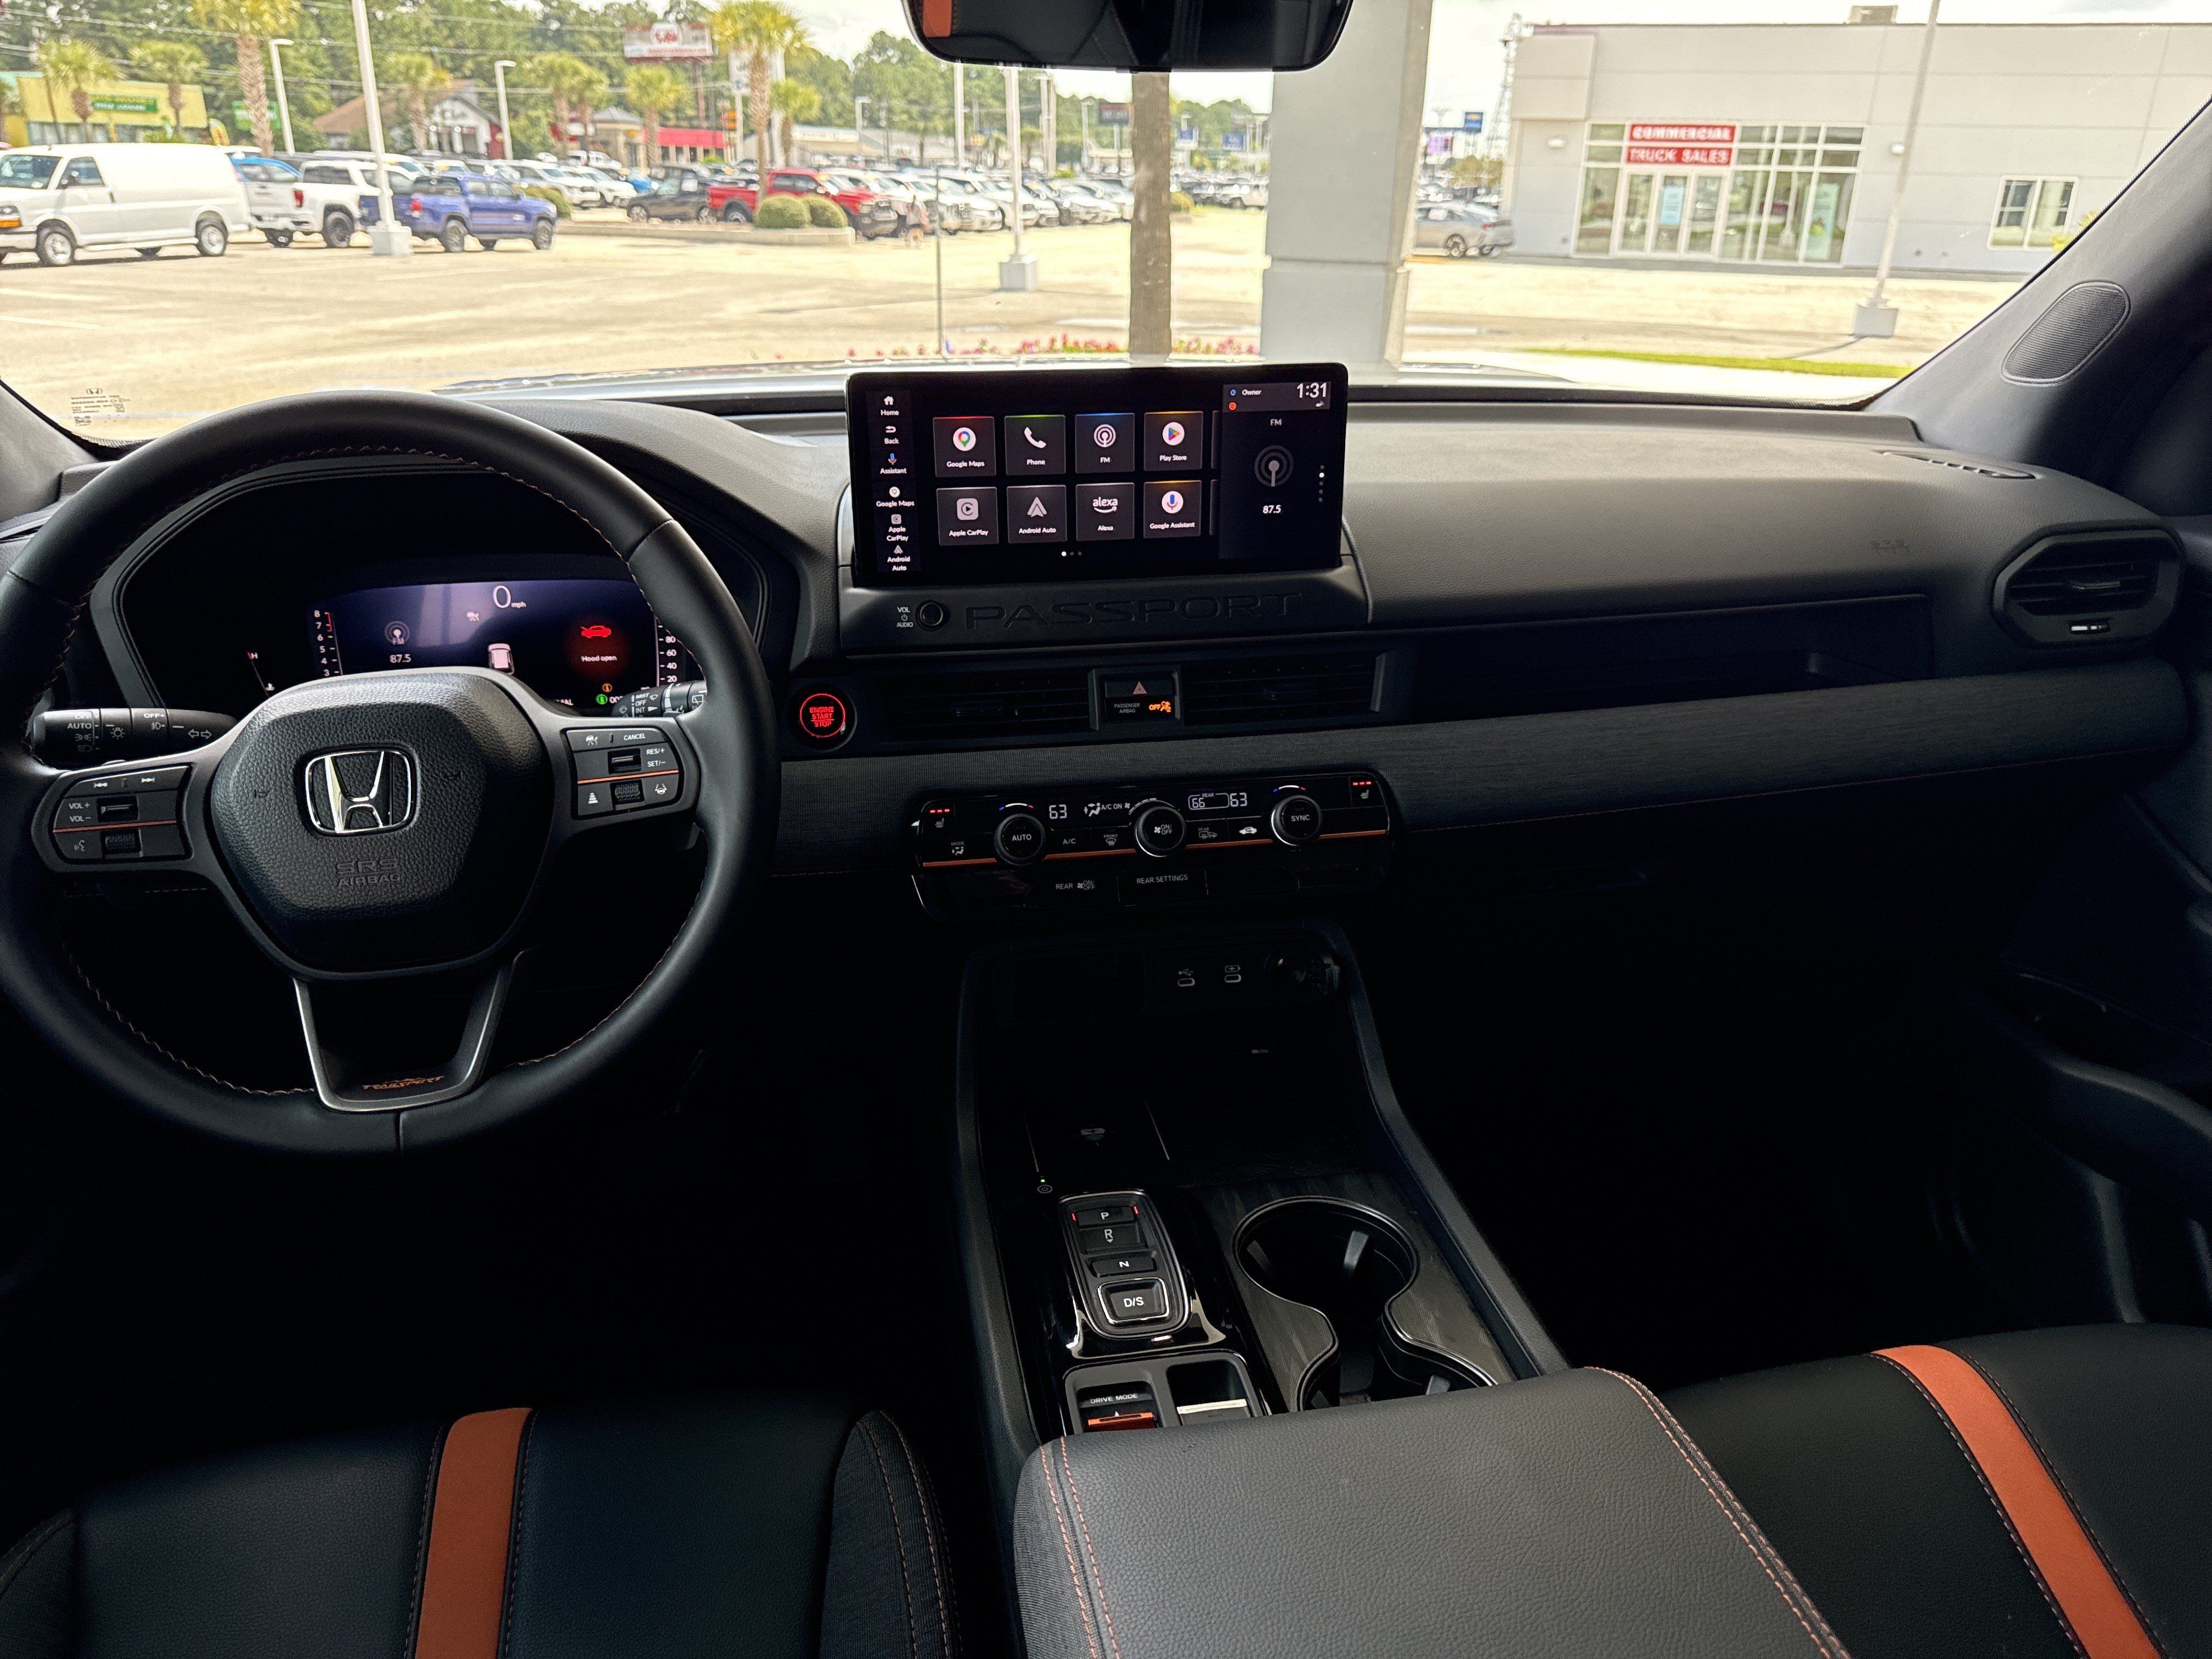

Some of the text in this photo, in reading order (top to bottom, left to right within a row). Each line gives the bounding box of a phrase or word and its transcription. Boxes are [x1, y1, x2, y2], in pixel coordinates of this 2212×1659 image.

[1632, 126, 1731, 140] COMMERCIAL
[1630, 148, 1729, 163] TRUCK SALES
[1296, 382, 1327, 398] 1:31
[1092, 496, 1118, 507] alexa
[1262, 504, 1282, 514] 87.5
[493, 585, 527, 609] 0 mph
[314, 610, 320, 618] 8
[966, 591, 1302, 629] PASSPORT
[389, 653, 411, 663] 87.5
[1192, 798, 1206, 808] 66
[1230, 792, 1248, 808] 63
[1048, 804, 1068, 820] 63
[1011, 833, 1032, 842] AUTO
[336, 858, 397, 874] SRS
[337, 873, 400, 887] AIRBAG
[1156, 874, 1188, 883] SETTINGS
[1101, 1212, 1109, 1220] P
[1104, 1229, 1113, 1239] R
[1123, 1296, 1144, 1307] D/S
